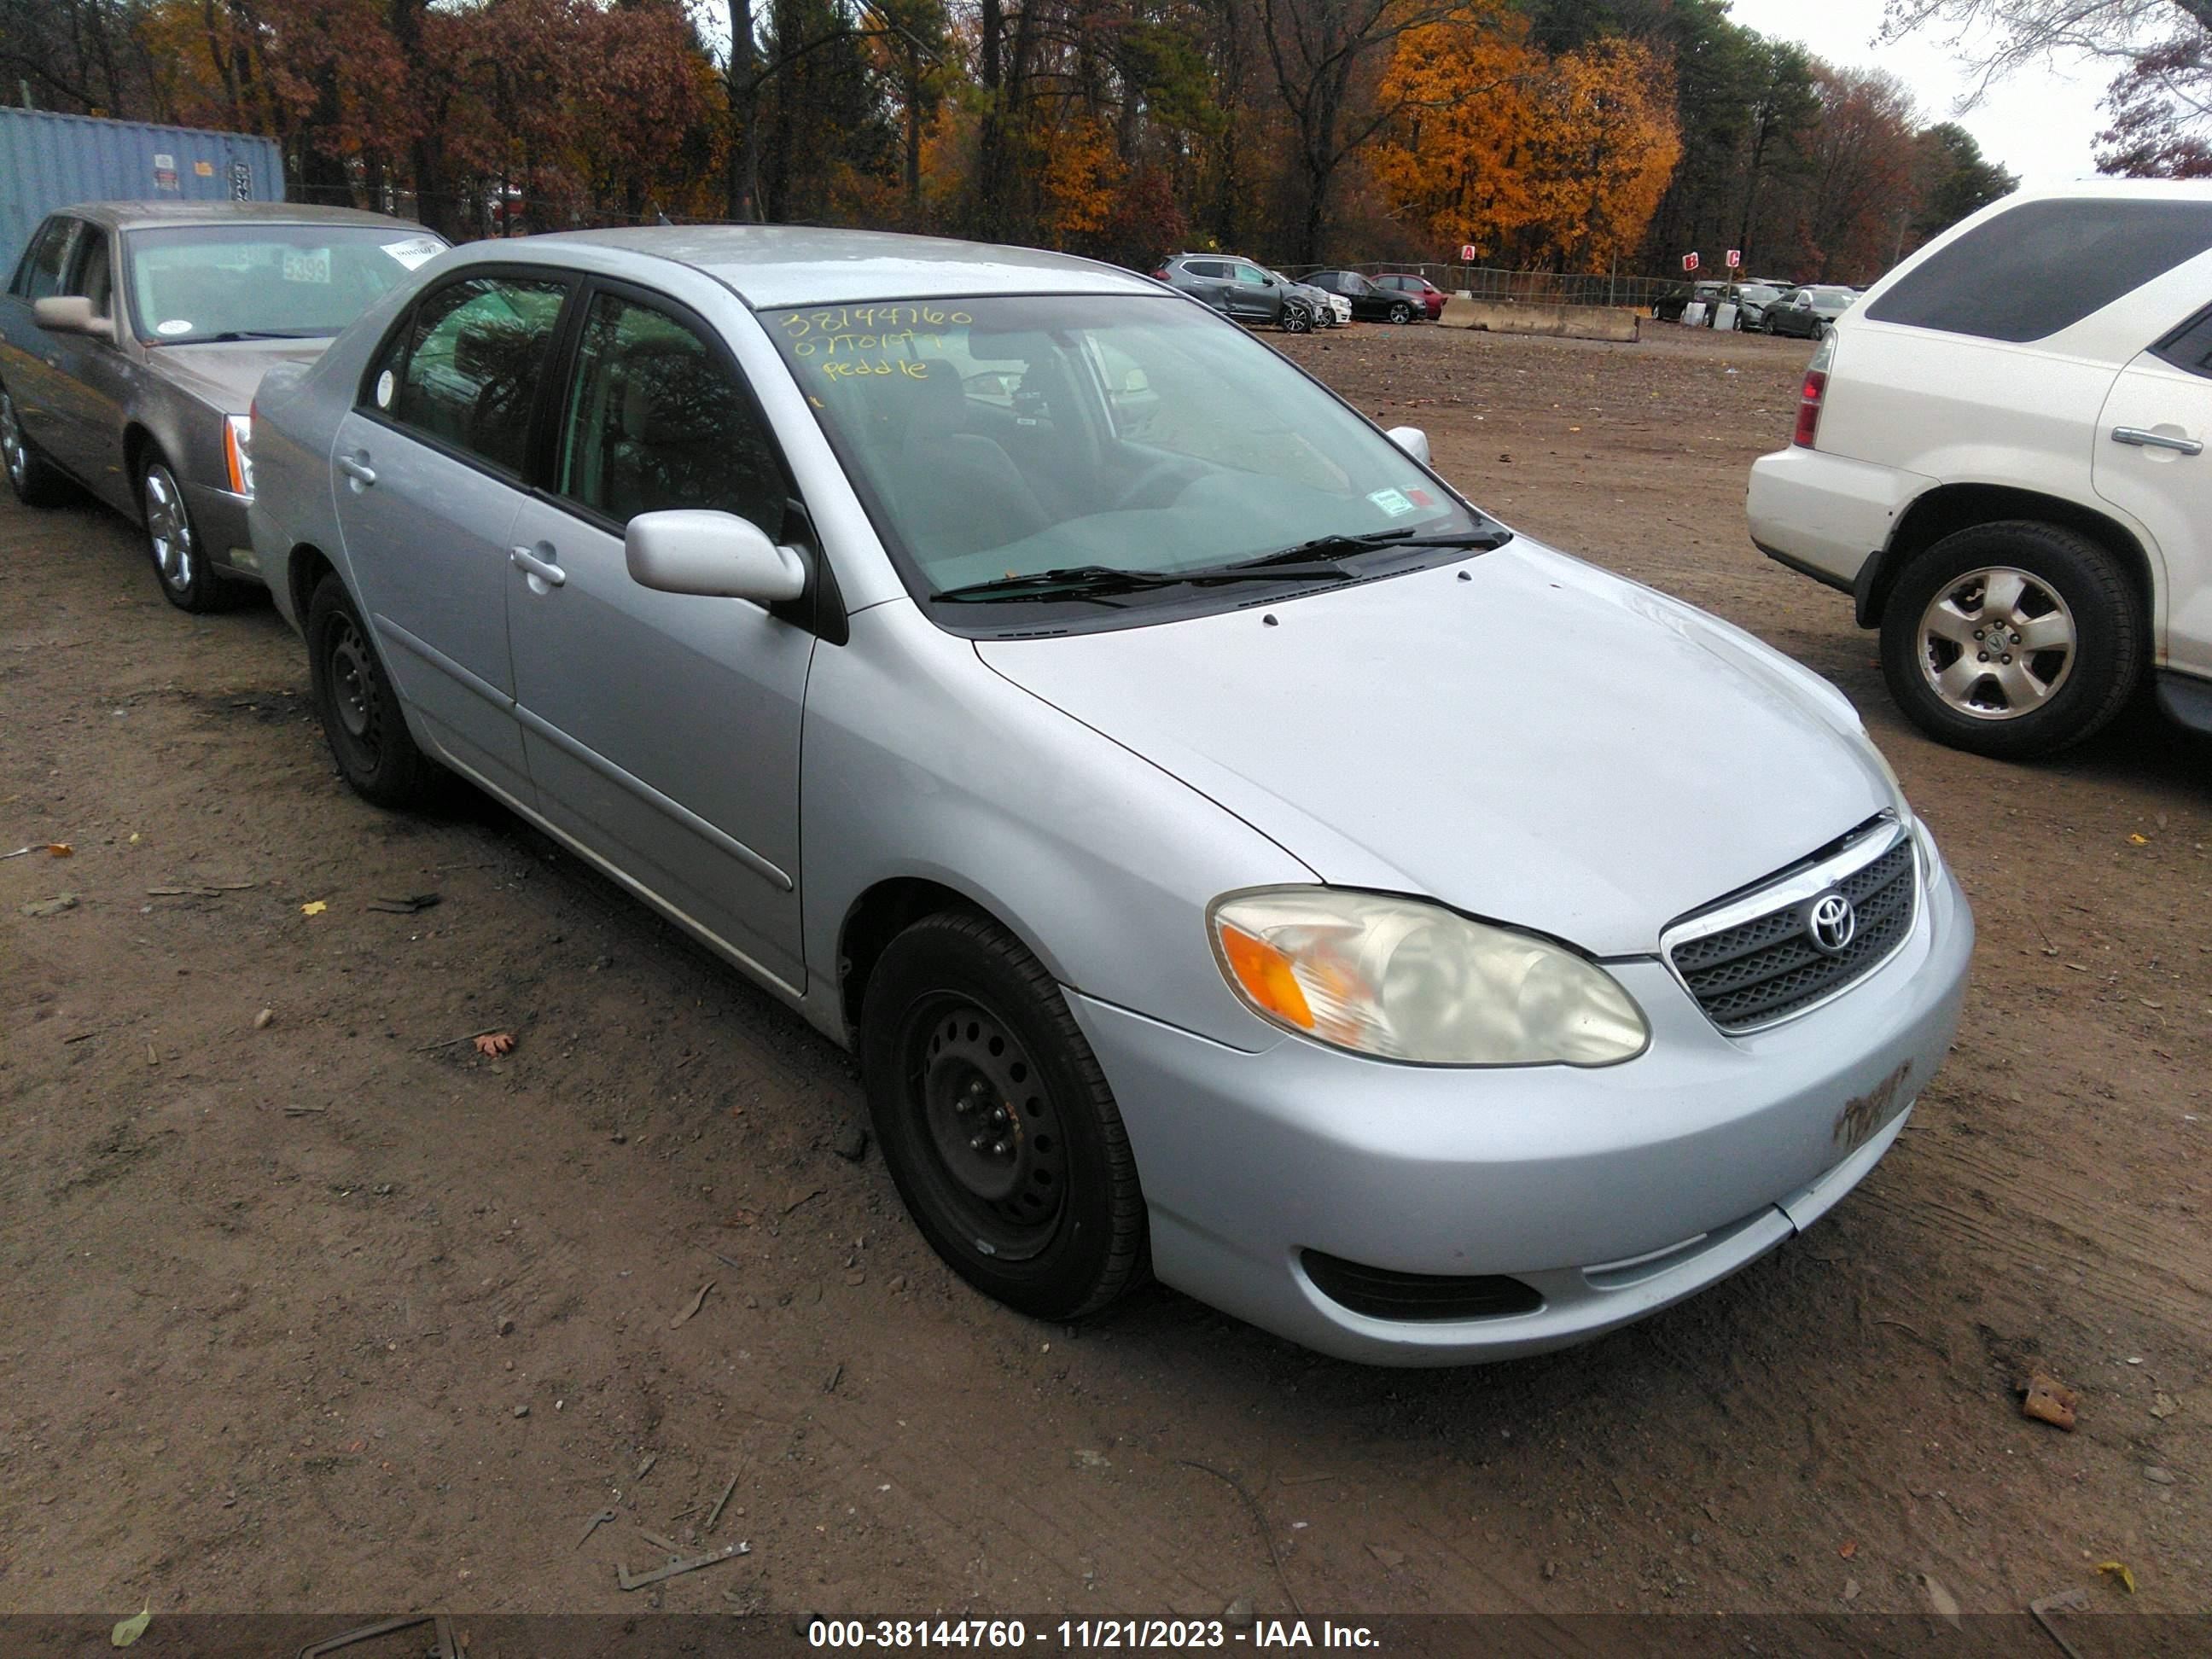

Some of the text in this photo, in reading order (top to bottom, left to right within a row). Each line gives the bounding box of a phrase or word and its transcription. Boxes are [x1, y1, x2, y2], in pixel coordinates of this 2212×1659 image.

[1463, 246, 1473, 259] A
[1729, 251, 1739, 265] C
[1685, 255, 1697, 270] B
[781, 307, 972, 337] 38144760
